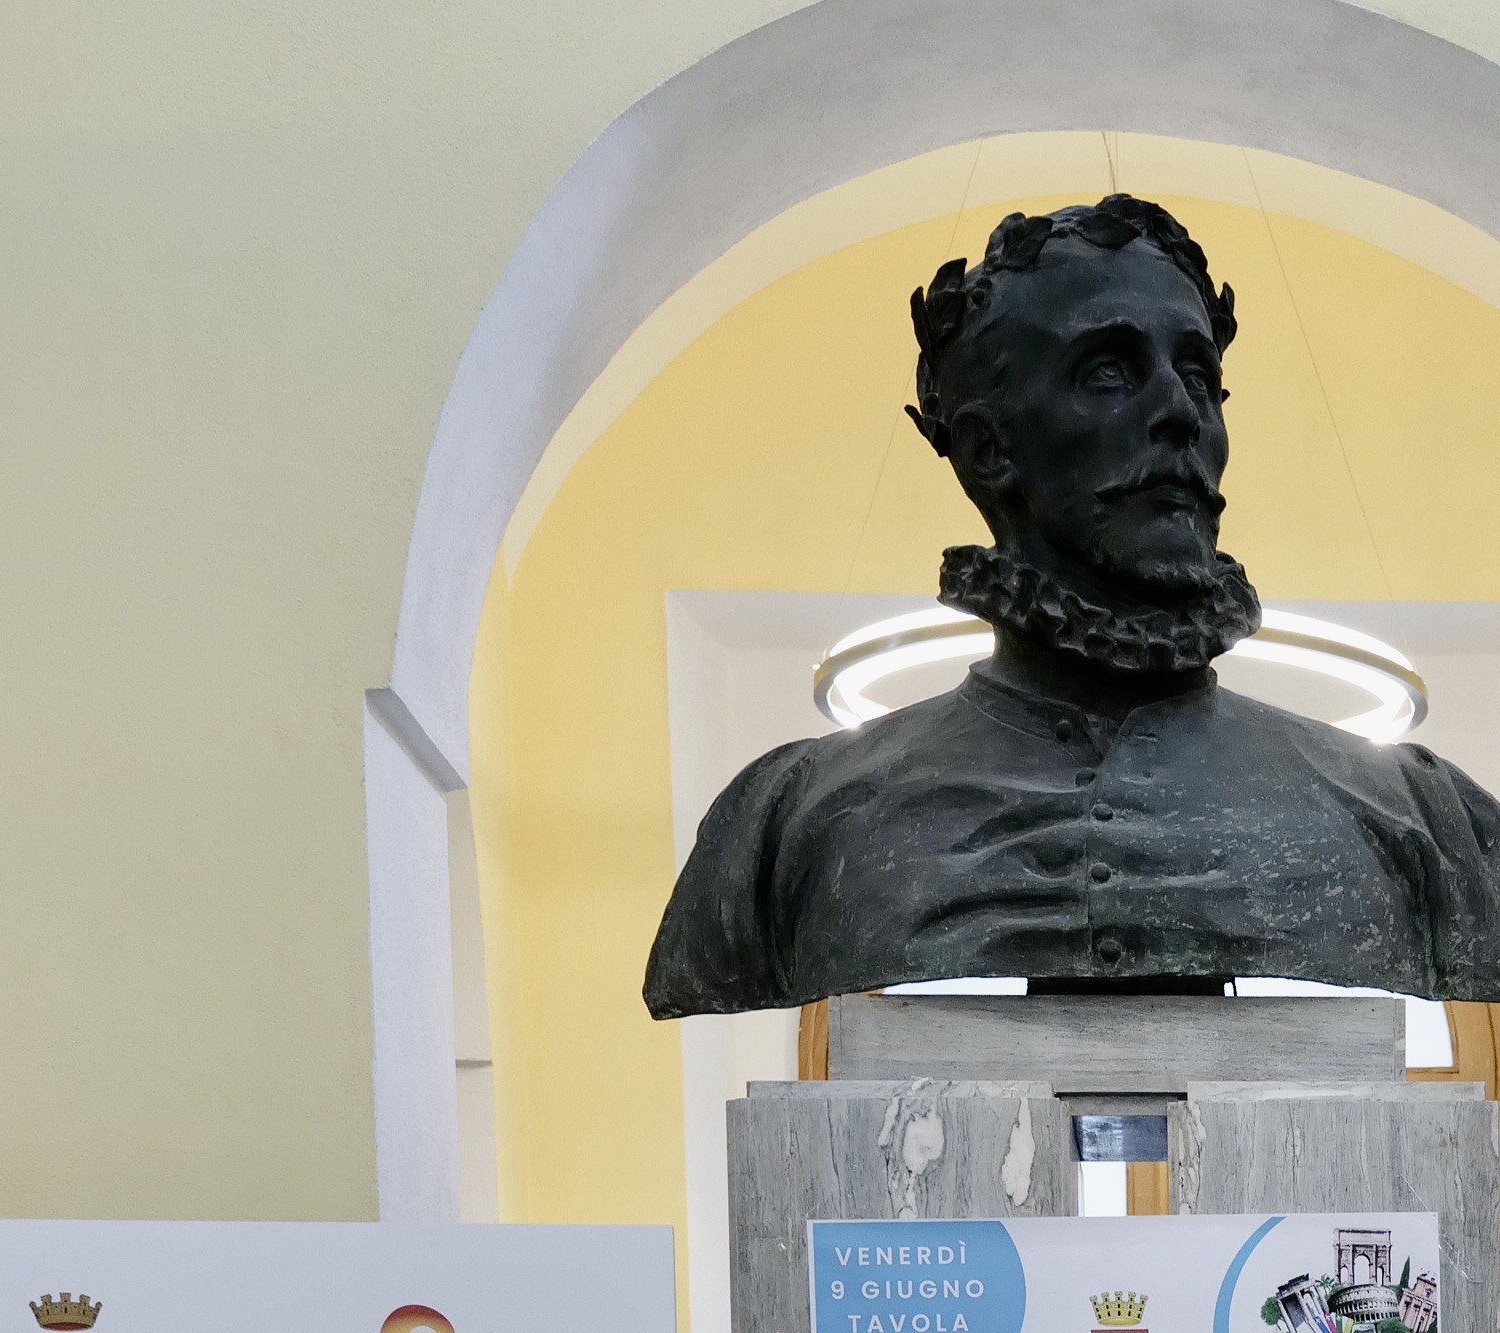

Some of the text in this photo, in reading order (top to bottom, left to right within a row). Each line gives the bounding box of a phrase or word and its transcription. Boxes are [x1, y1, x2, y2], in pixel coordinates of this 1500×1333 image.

[835, 1240, 967, 1266] VENERDÌ
[830, 1278, 986, 1299] 9 GIUGNO
[847, 1313, 969, 1333] TAVOLA
